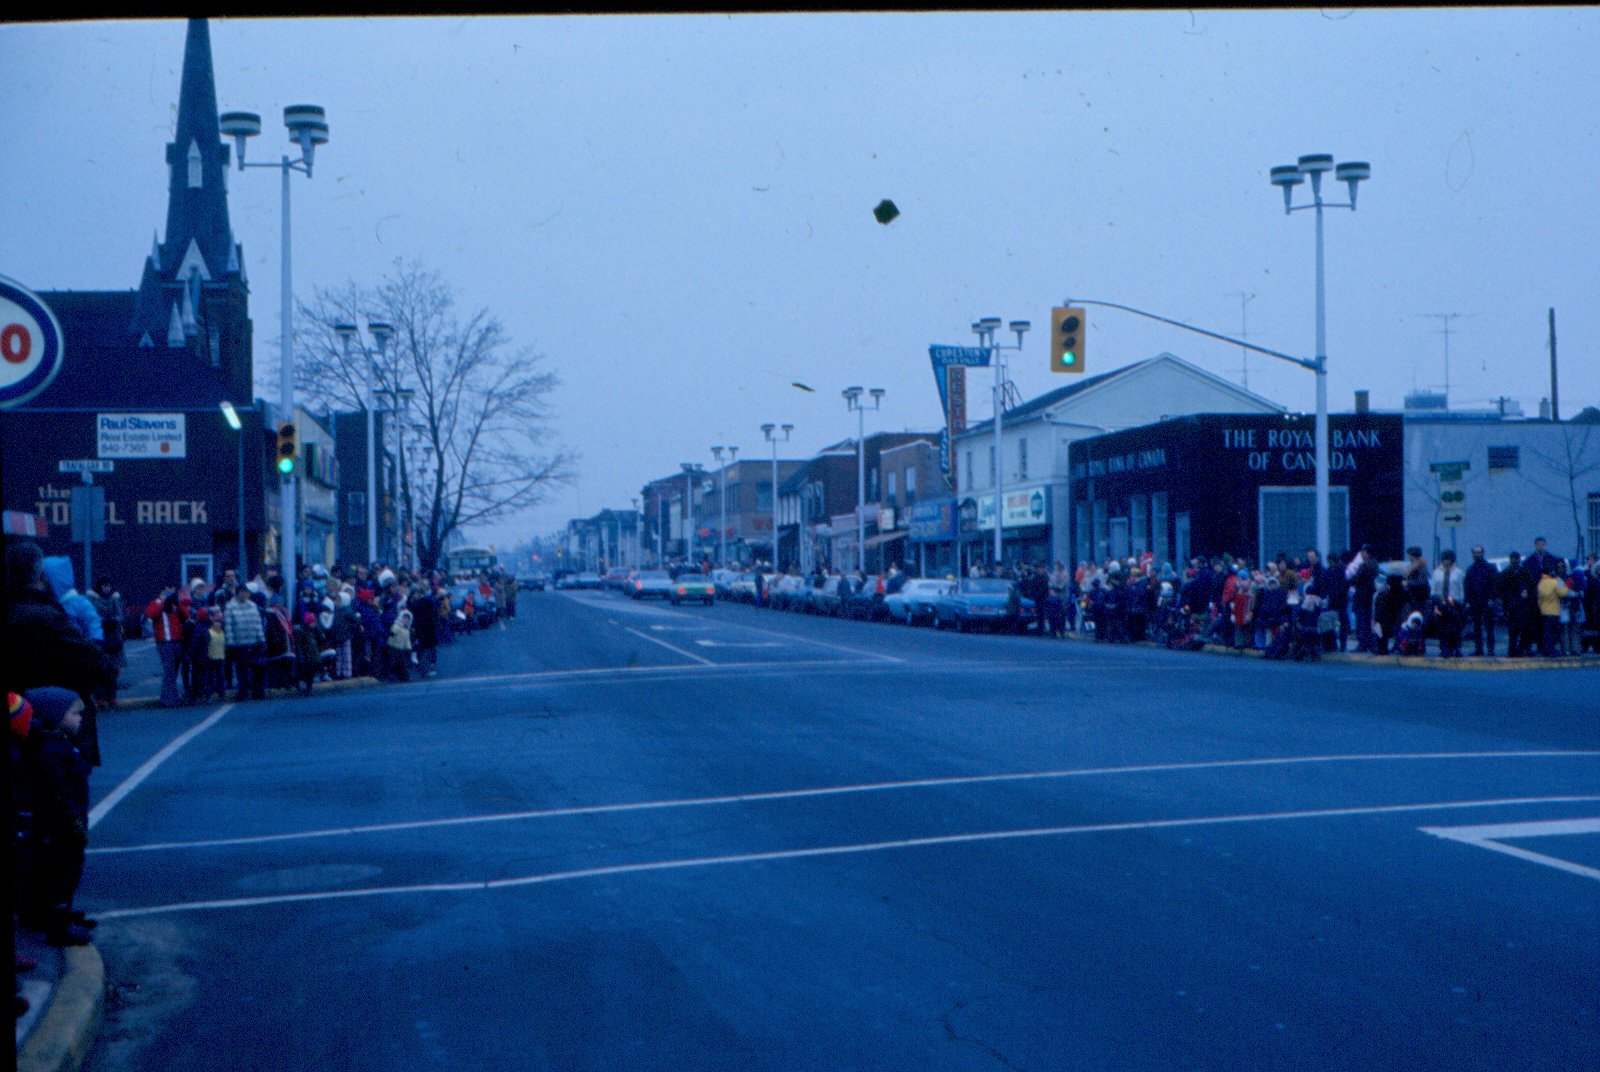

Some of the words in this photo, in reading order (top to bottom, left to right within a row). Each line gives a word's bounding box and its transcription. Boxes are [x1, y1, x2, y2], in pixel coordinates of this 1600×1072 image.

[101, 417, 127, 430] Paul
[101, 432, 121, 442] Real
[123, 432, 151, 442] Estate
[152, 432, 182, 442] Limited
[1223, 430, 1256, 448] THE
[1268, 430, 1315, 448] ROYA
[1333, 430, 1381, 448] BANK
[1248, 452, 1271, 470] OF
[1282, 452, 1357, 470] CANDA
[38, 484, 71, 498] the
[35, 501, 125, 524] TOL
[137, 501, 207, 524] RACK
